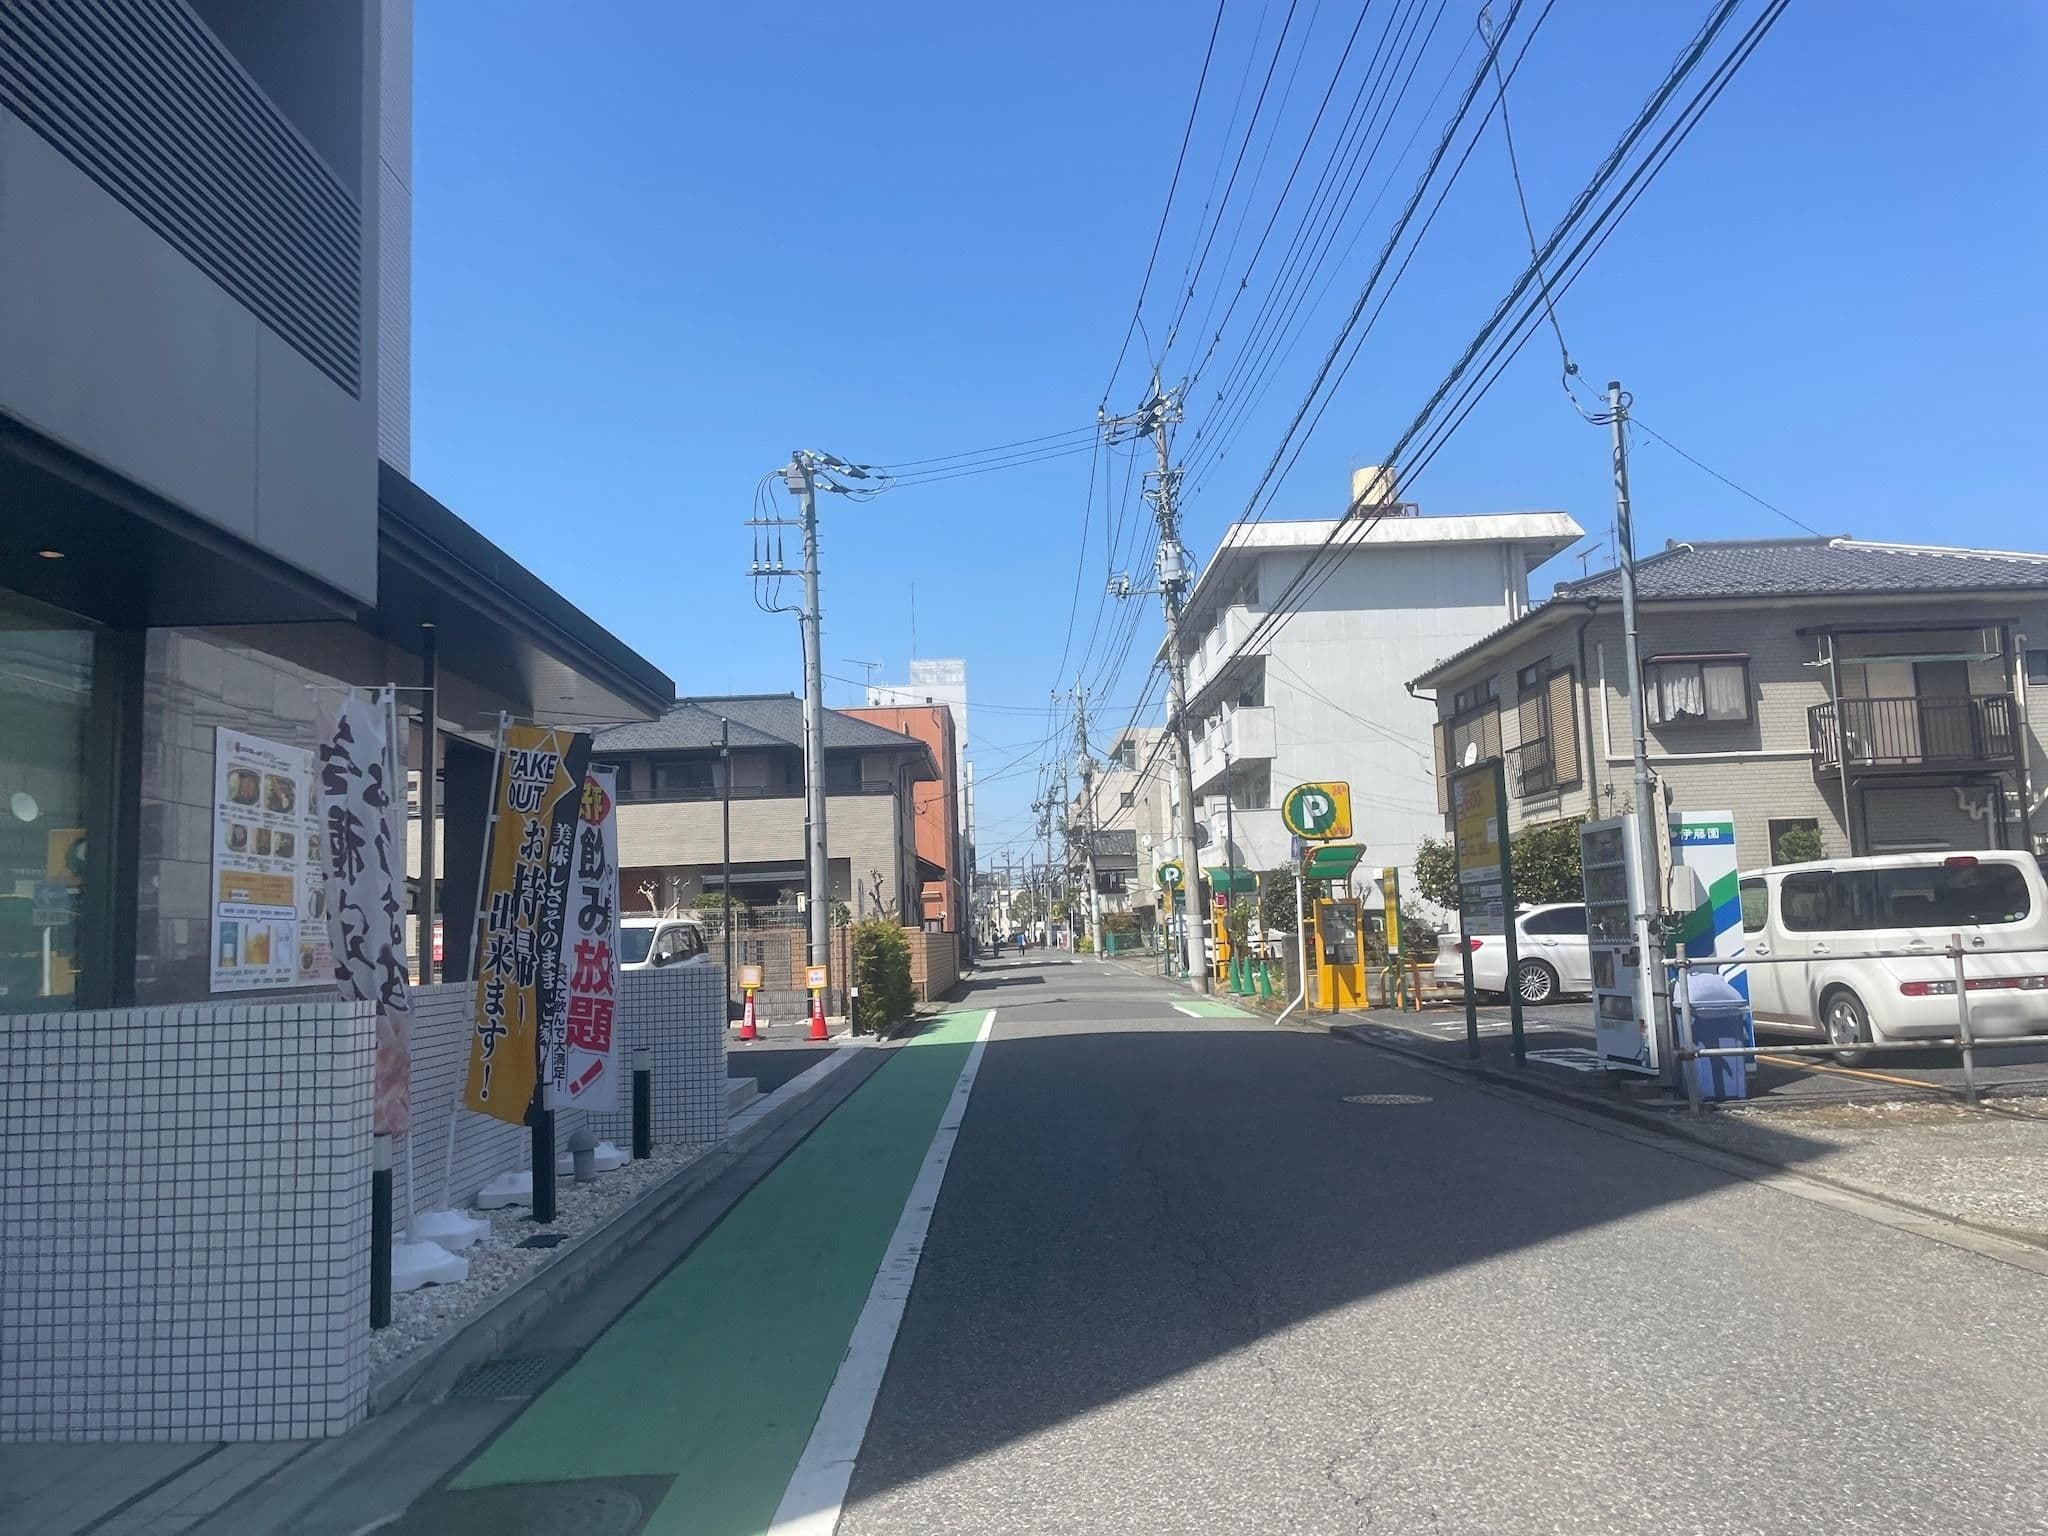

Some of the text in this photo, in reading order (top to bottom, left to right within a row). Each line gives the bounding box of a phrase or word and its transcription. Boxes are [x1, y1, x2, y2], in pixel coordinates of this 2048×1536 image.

[508, 750, 558, 783] TAKE
[1303, 794, 1329, 830] P
[1680, 827, 1720, 841] 伊藤園
